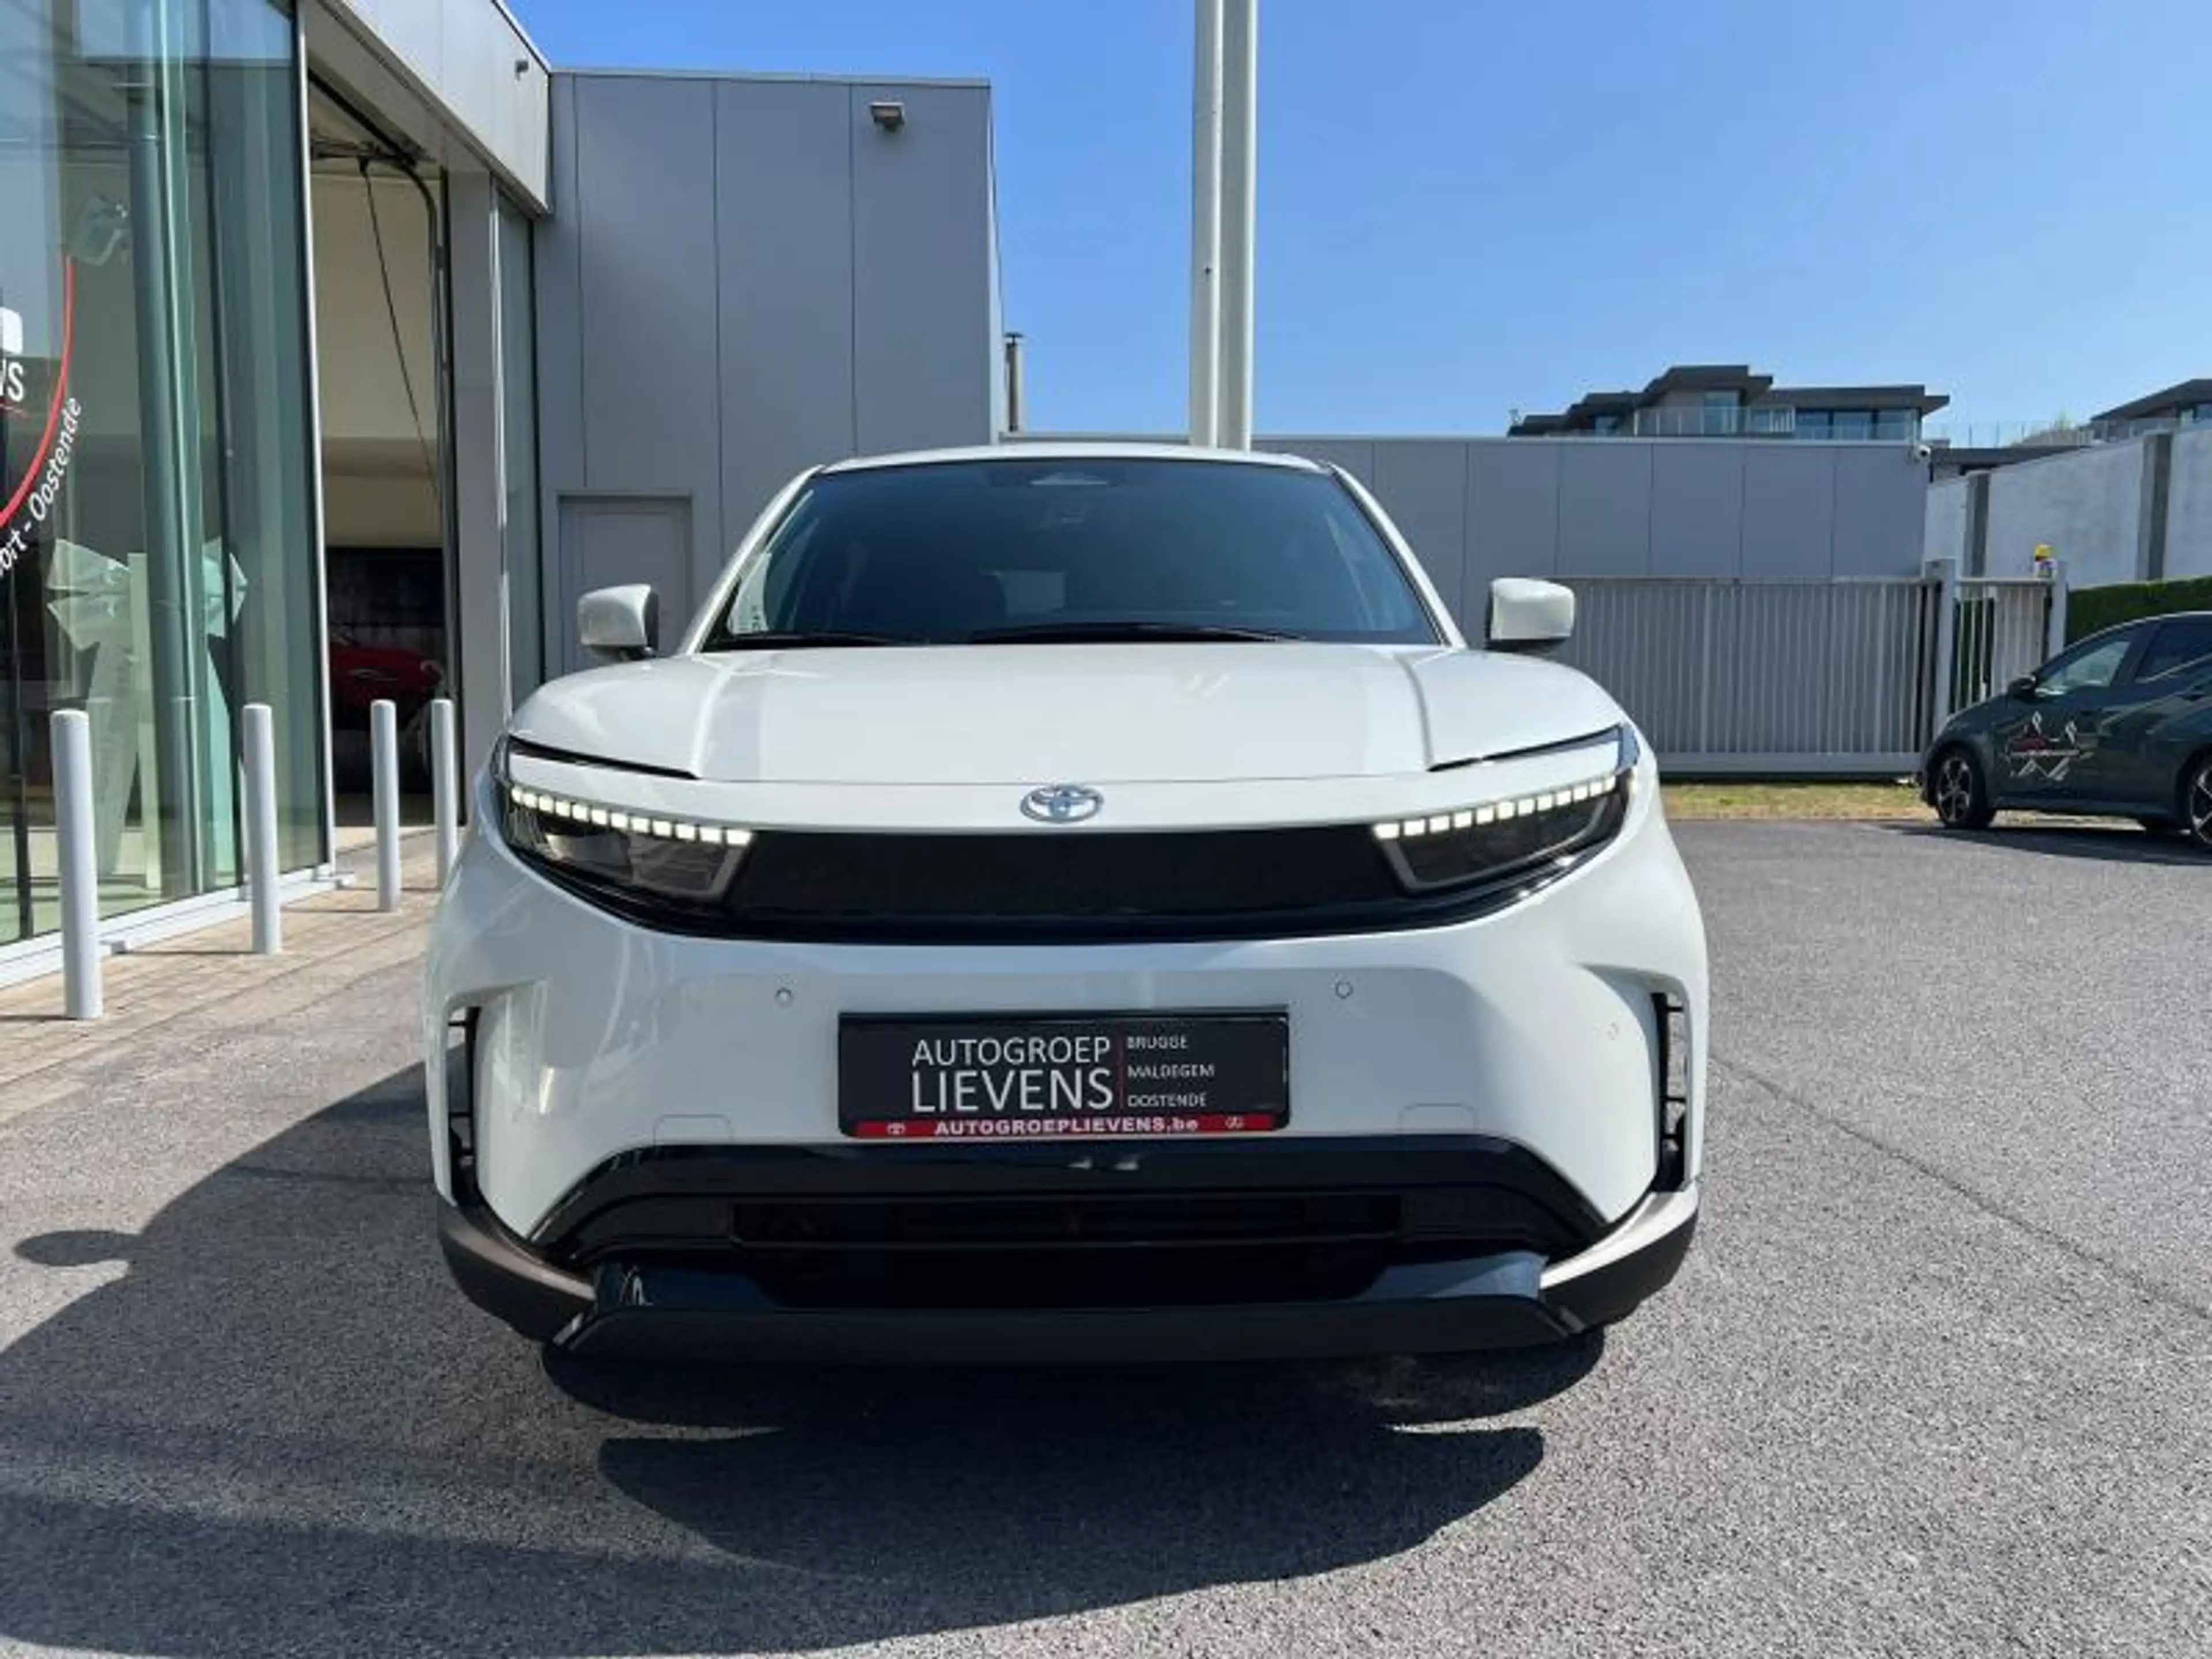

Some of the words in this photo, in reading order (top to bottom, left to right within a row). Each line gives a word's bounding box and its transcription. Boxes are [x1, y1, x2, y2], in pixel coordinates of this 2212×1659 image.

[29, 397, 81, 521] Oostende
[912, 1036, 1111, 1066] AUTOGROEP
[1127, 1035, 1188, 1049] BRUGGE
[1127, 1063, 1215, 1079] MALDEGEM
[912, 1067, 1113, 1112] LIEVENS
[1127, 1093, 1207, 1108] OOSTENDE
[934, 1116, 1199, 1135] AUTOGROEPLIEVENS.be
